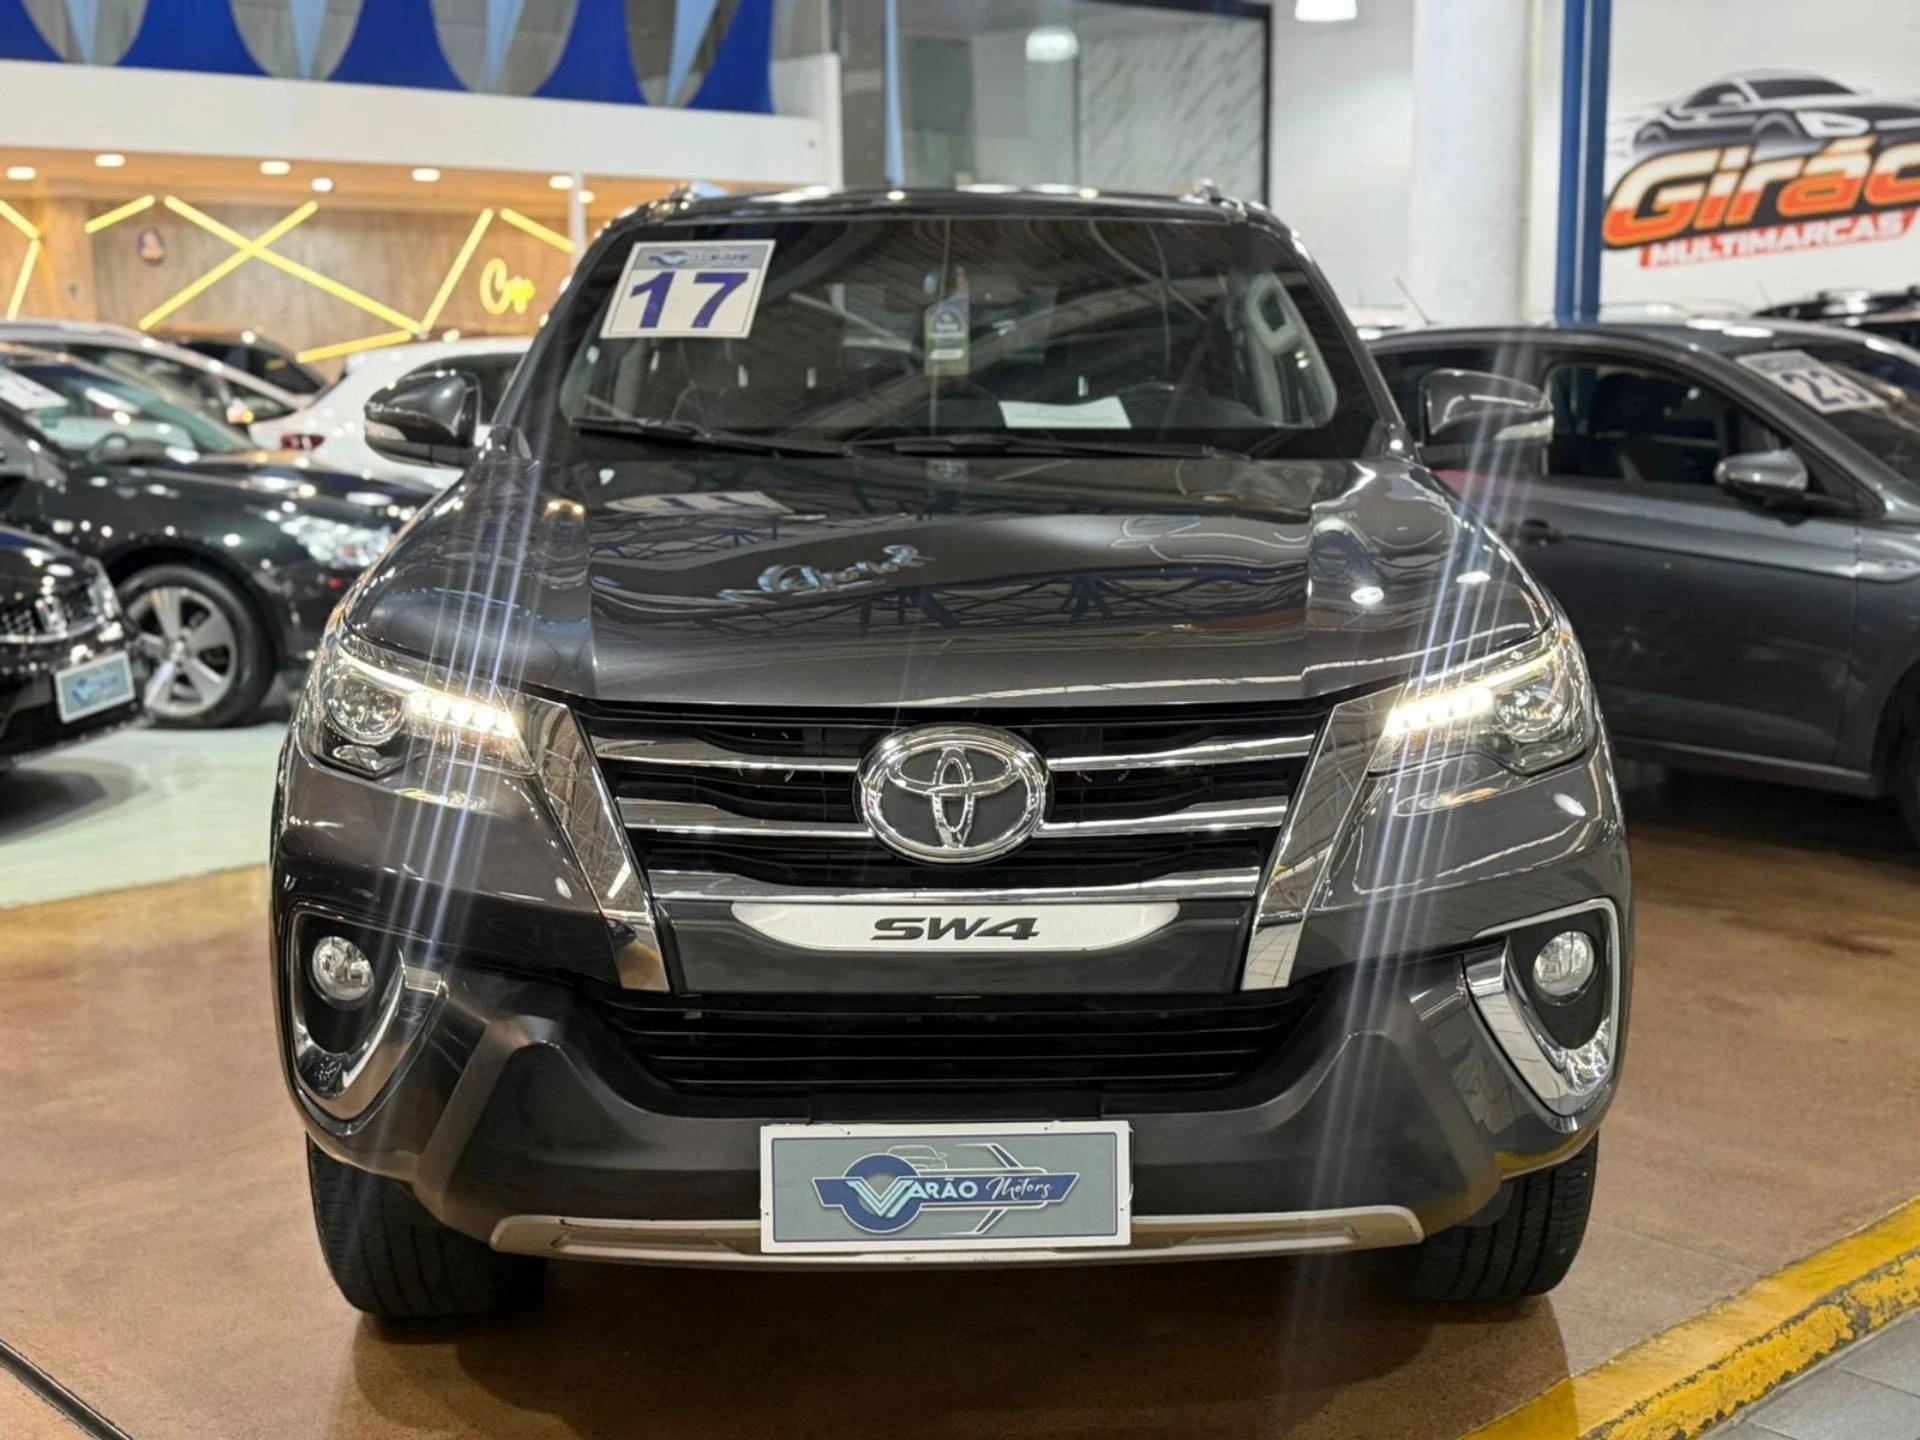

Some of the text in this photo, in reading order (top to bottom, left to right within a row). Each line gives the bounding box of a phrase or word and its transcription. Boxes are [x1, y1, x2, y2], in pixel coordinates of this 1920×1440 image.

[1648, 208, 1906, 269] MULTIMARCAS
[630, 271, 750, 329] 17
[870, 917, 1040, 941] SW4
[985, 1176, 1053, 1201] Motors
